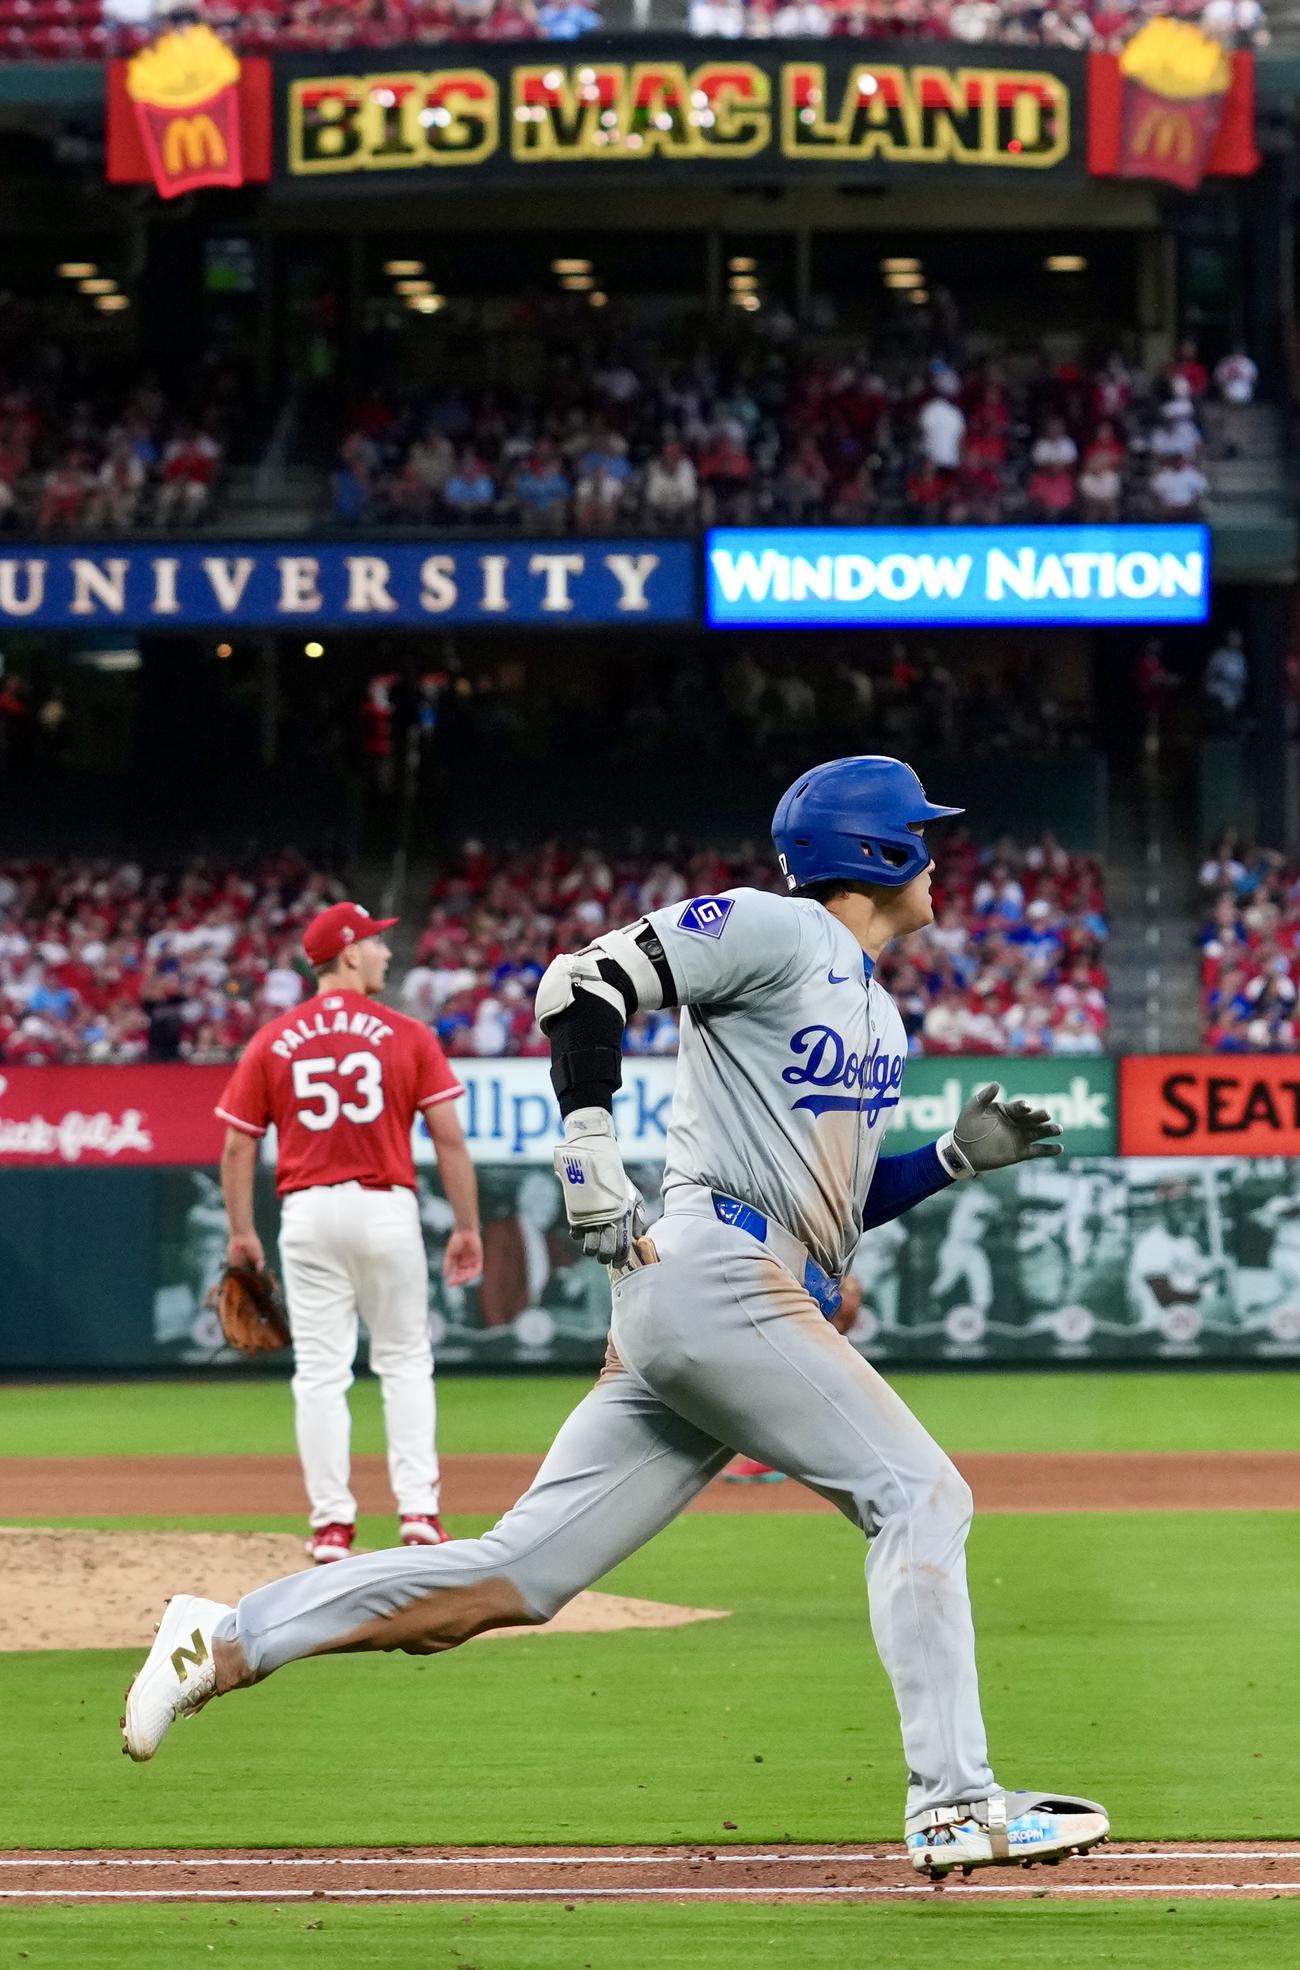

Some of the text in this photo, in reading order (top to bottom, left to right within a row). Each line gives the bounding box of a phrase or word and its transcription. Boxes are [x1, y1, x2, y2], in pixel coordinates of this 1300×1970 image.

[289, 62, 1071, 175] BIG MAC LAND
[0, 554, 660, 615] UNIVERSITY
[272, 1010, 394, 1059] PALLANTE
[292, 1051, 385, 1131] 53
[782, 1024, 904, 1129] Dodge
[1008, 1828, 1044, 1842] EKOPIN
